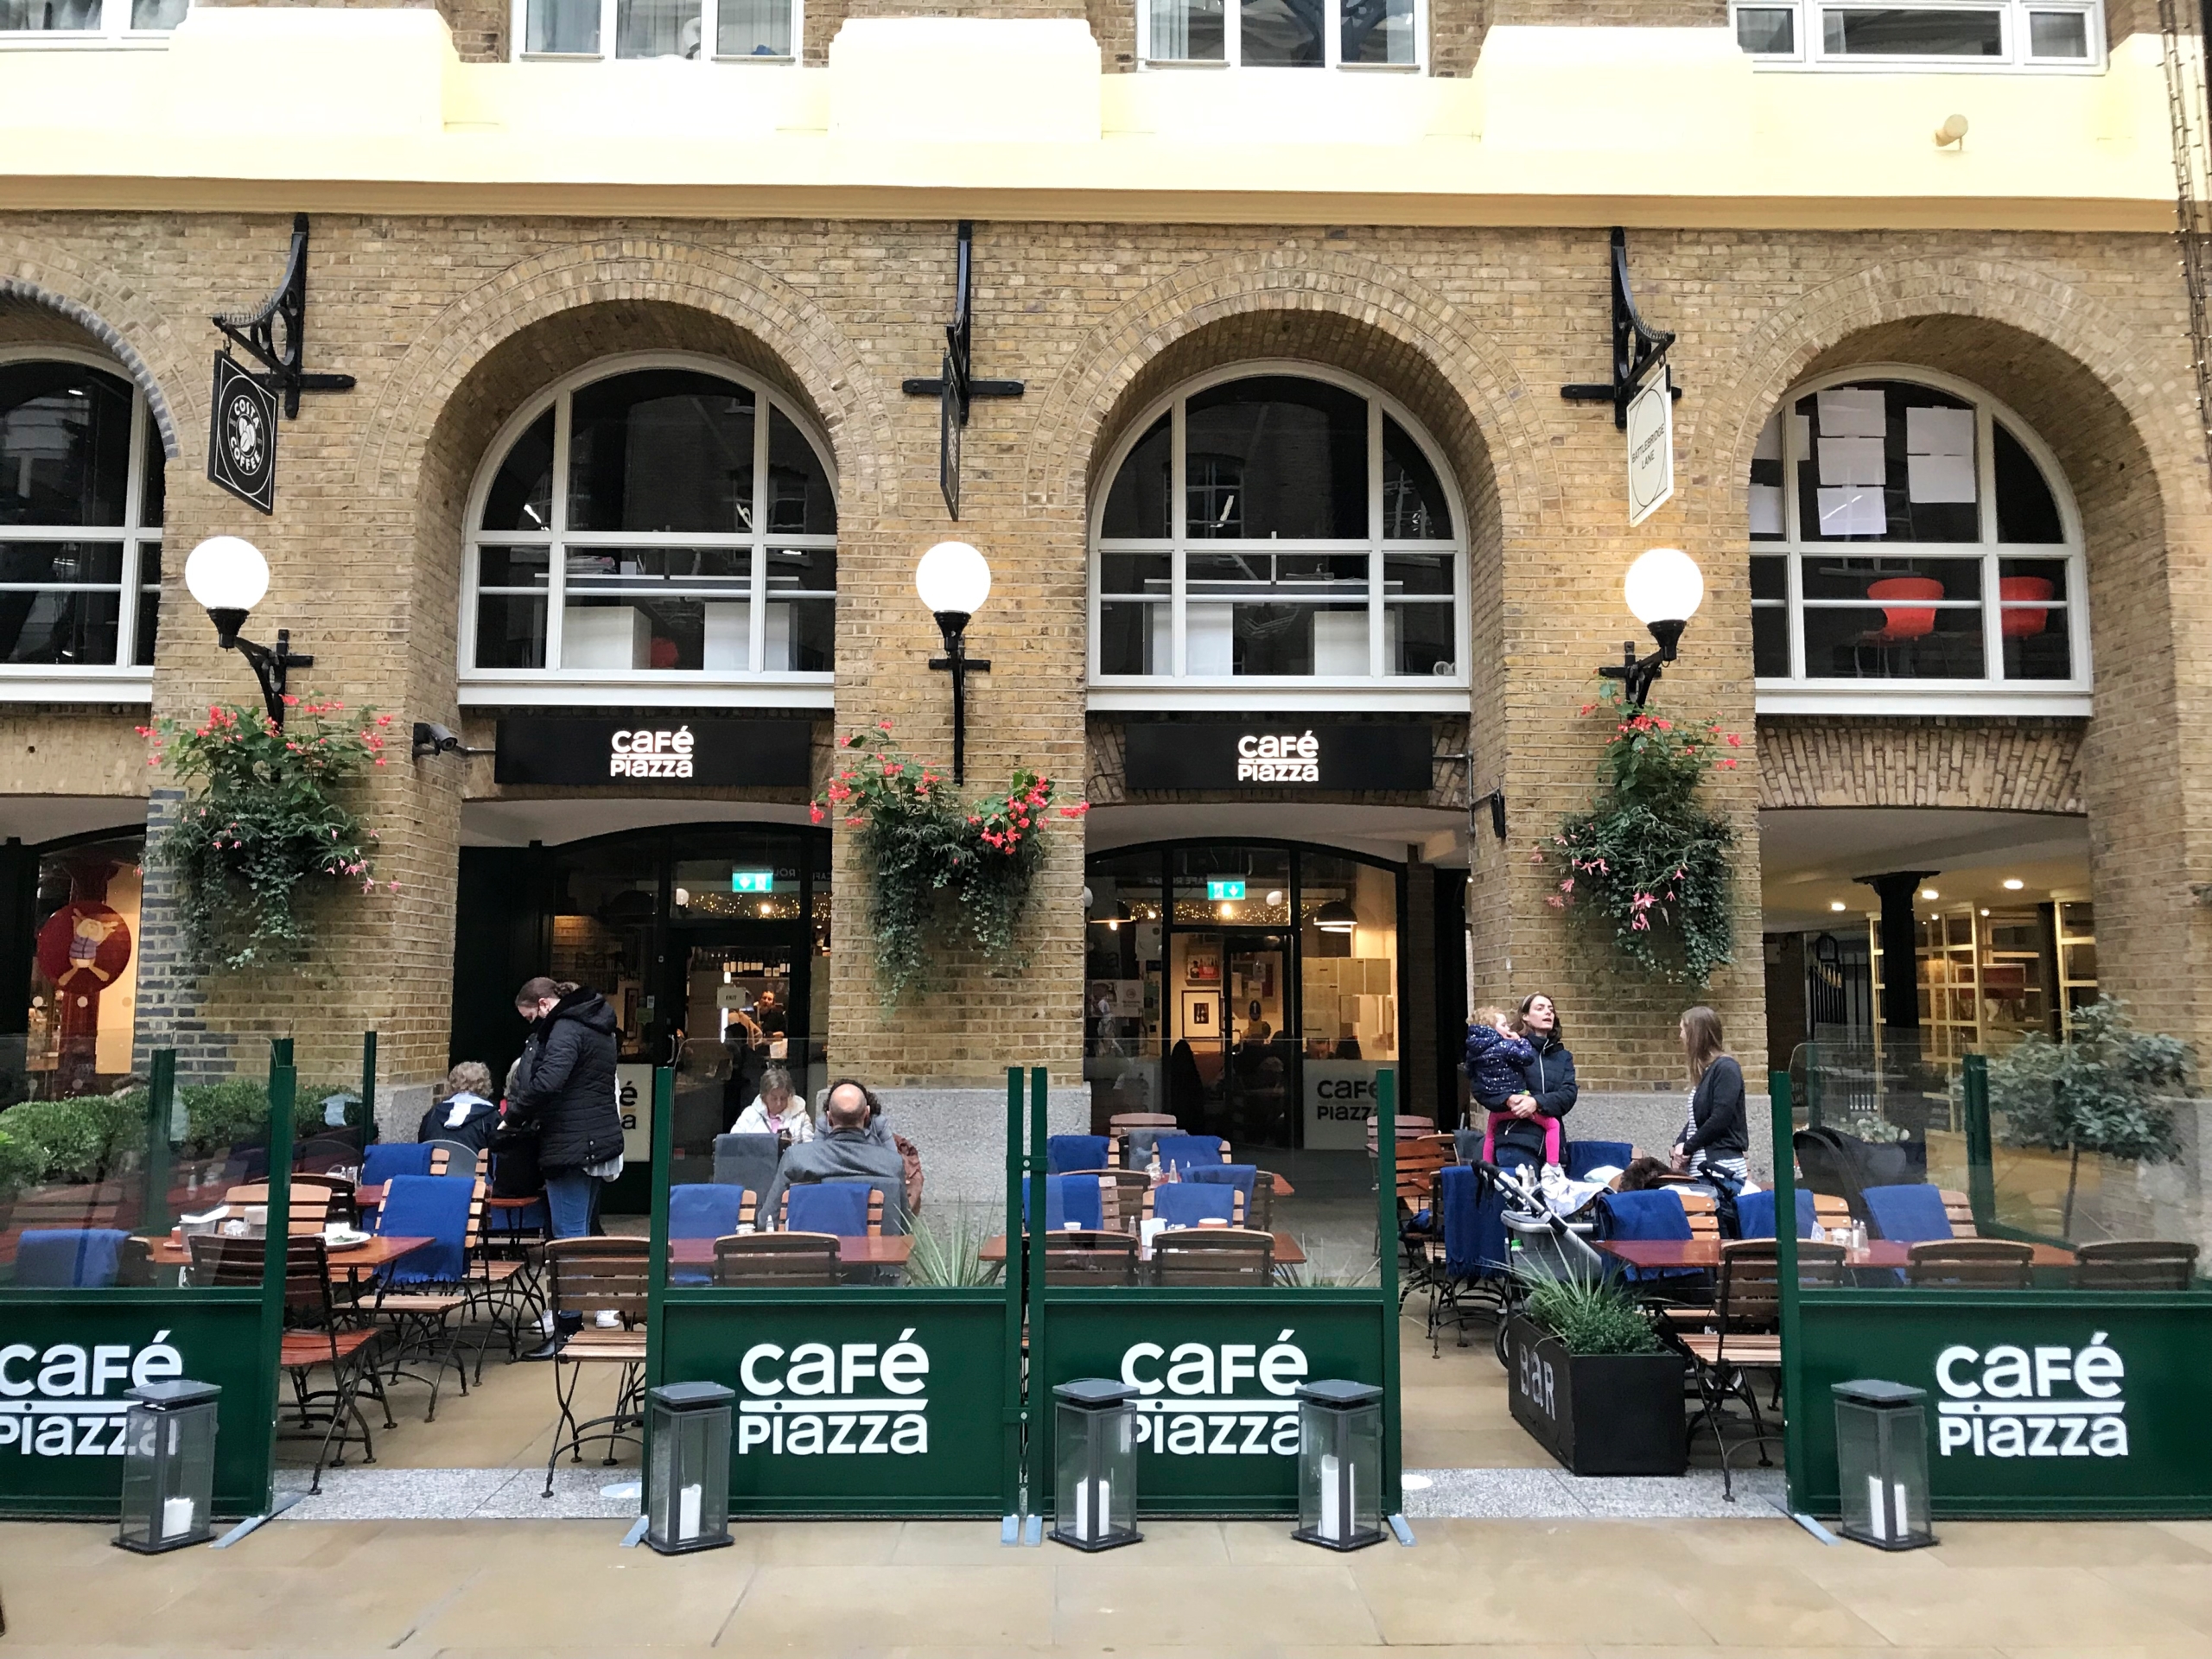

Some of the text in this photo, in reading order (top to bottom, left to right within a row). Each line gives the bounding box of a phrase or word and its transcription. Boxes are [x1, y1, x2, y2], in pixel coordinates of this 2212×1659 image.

[234, 398, 260, 429] COSTA
[230, 436, 261, 471] COFFEE
[1631, 423, 1665, 464] BATTLEBRIDGE
[1641, 449, 1656, 470] LANE
[1317, 1106, 1377, 1121] Piazz
[739, 1414, 928, 1456] Piazza
[1938, 1416, 2129, 1458] Piazza
